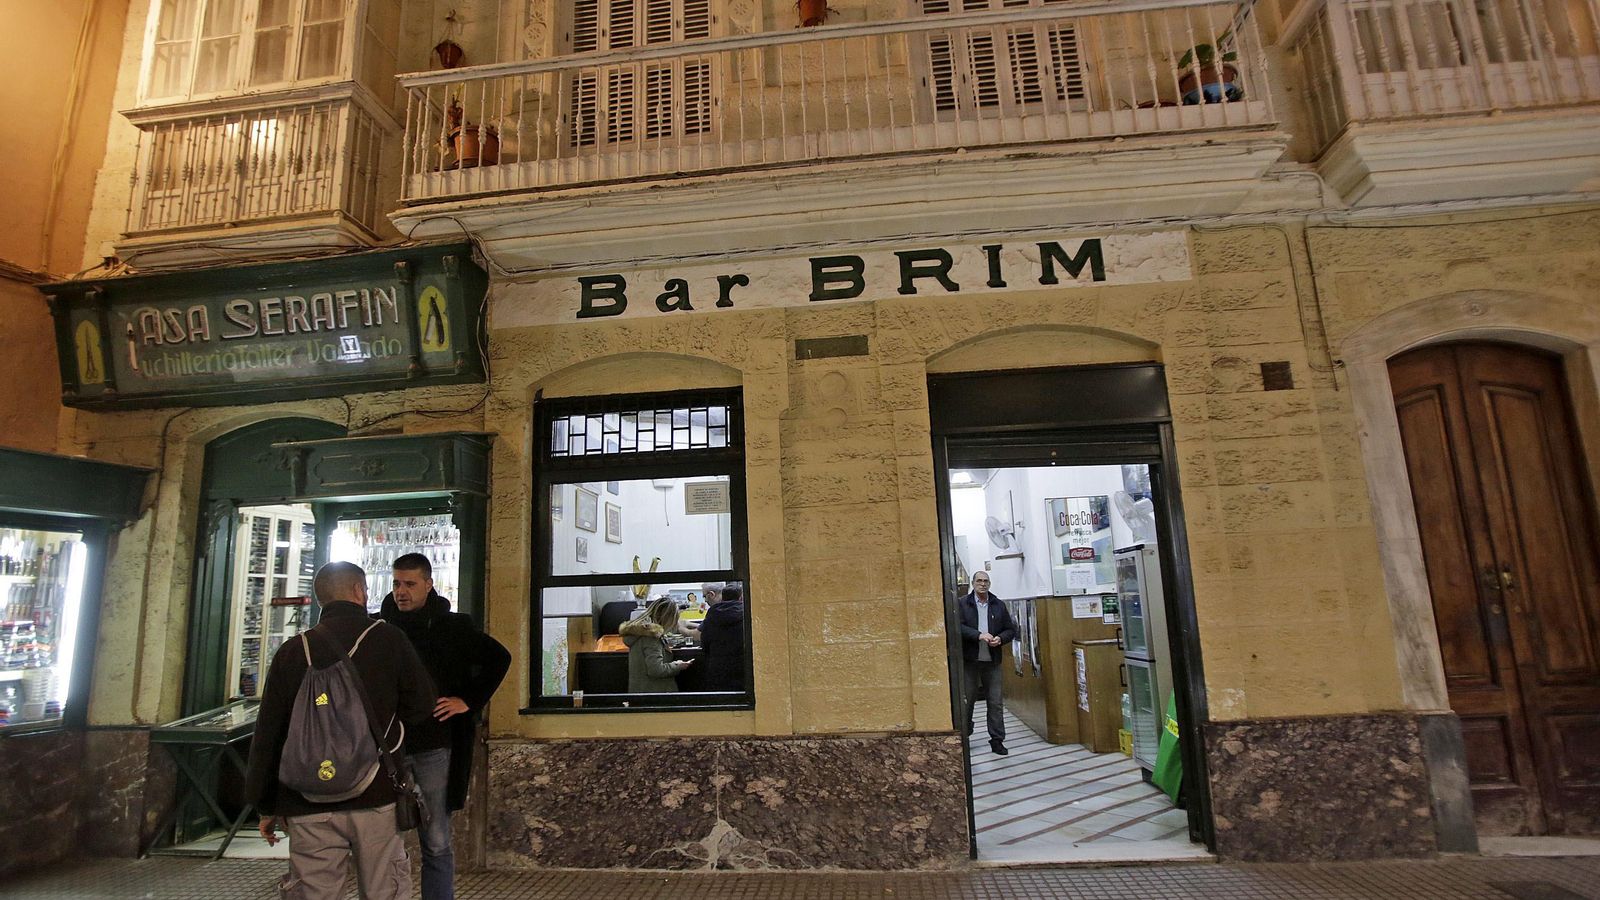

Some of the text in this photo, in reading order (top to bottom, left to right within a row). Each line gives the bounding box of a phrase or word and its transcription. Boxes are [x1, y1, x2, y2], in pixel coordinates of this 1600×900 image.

[576, 238, 1106, 319] Bar BRIM
[222, 286, 399, 339] SERAFIN
